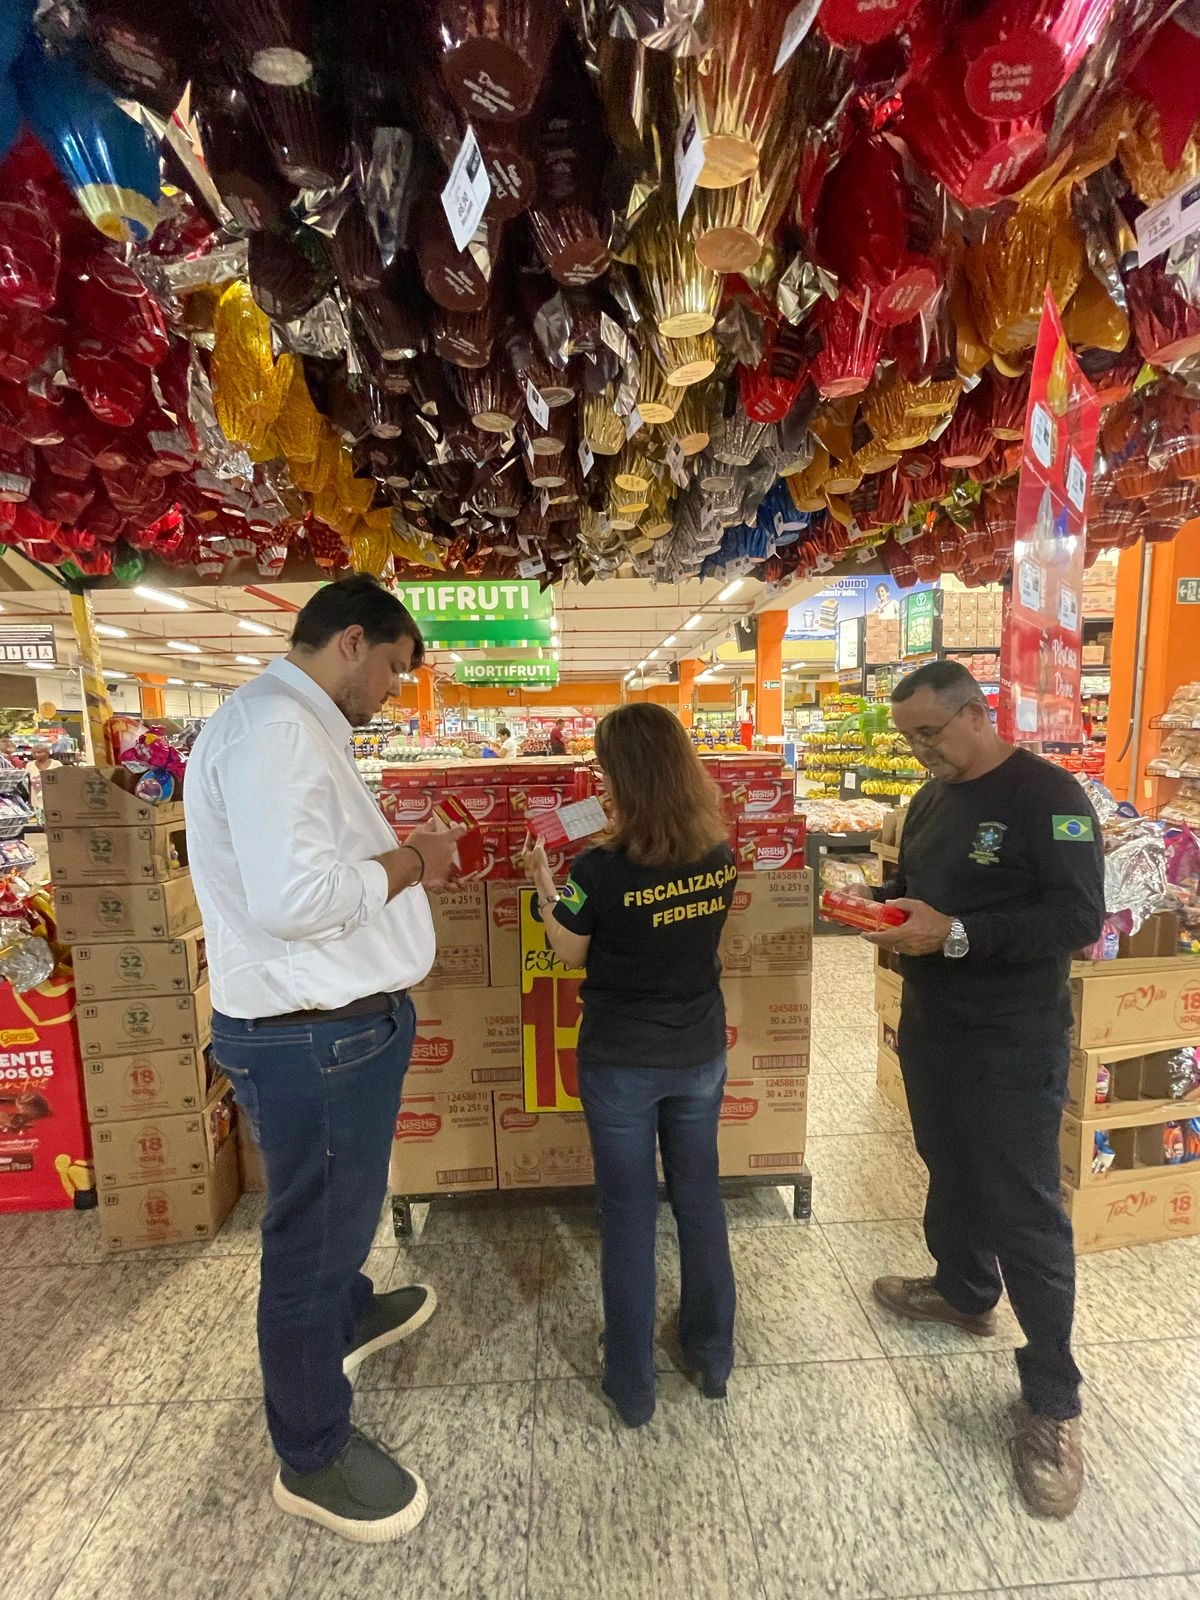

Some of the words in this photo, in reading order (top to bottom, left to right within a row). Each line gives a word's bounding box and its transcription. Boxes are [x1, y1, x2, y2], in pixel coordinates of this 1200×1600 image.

[464, 665, 550, 677] HORTIFRUTI
[85, 781, 108, 794] 32
[90, 839, 113, 853] 32
[757, 846, 786, 856] Nestlé
[623, 865, 737, 907] FISCALIZAÇÃO
[769, 883, 779, 893] 30
[788, 883, 802, 892] 251
[804, 884, 810, 894] g
[101, 900, 123, 914] 32
[439, 896, 449, 905] 30
[458, 895, 473, 904] 251
[475, 897, 481, 906] g
[653, 896, 726, 928] FEDERAL
[119, 955, 143, 969] 32
[127, 1011, 151, 1024] 32
[484, 1015, 520, 1026] 1245881
[769, 1016, 779, 1025] 30
[788, 1015, 802, 1024] 251
[486, 1028, 496, 1037] 30
[411, 1043, 449, 1058] estlé
[30, 1065, 54, 1078] OS
[129, 1069, 154, 1085] 18
[765, 1090, 775, 1099] 30
[784, 1089, 798, 1098] 251
[799, 1090, 805, 1100] g
[448, 1104, 458, 1114] 30
[483, 1104, 489, 1114] g
[396, 1118, 438, 1132] Nestlé
[137, 1136, 163, 1152] 18
[144, 1199, 169, 1215] 18
[1169, 1195, 1192, 1213] 18
